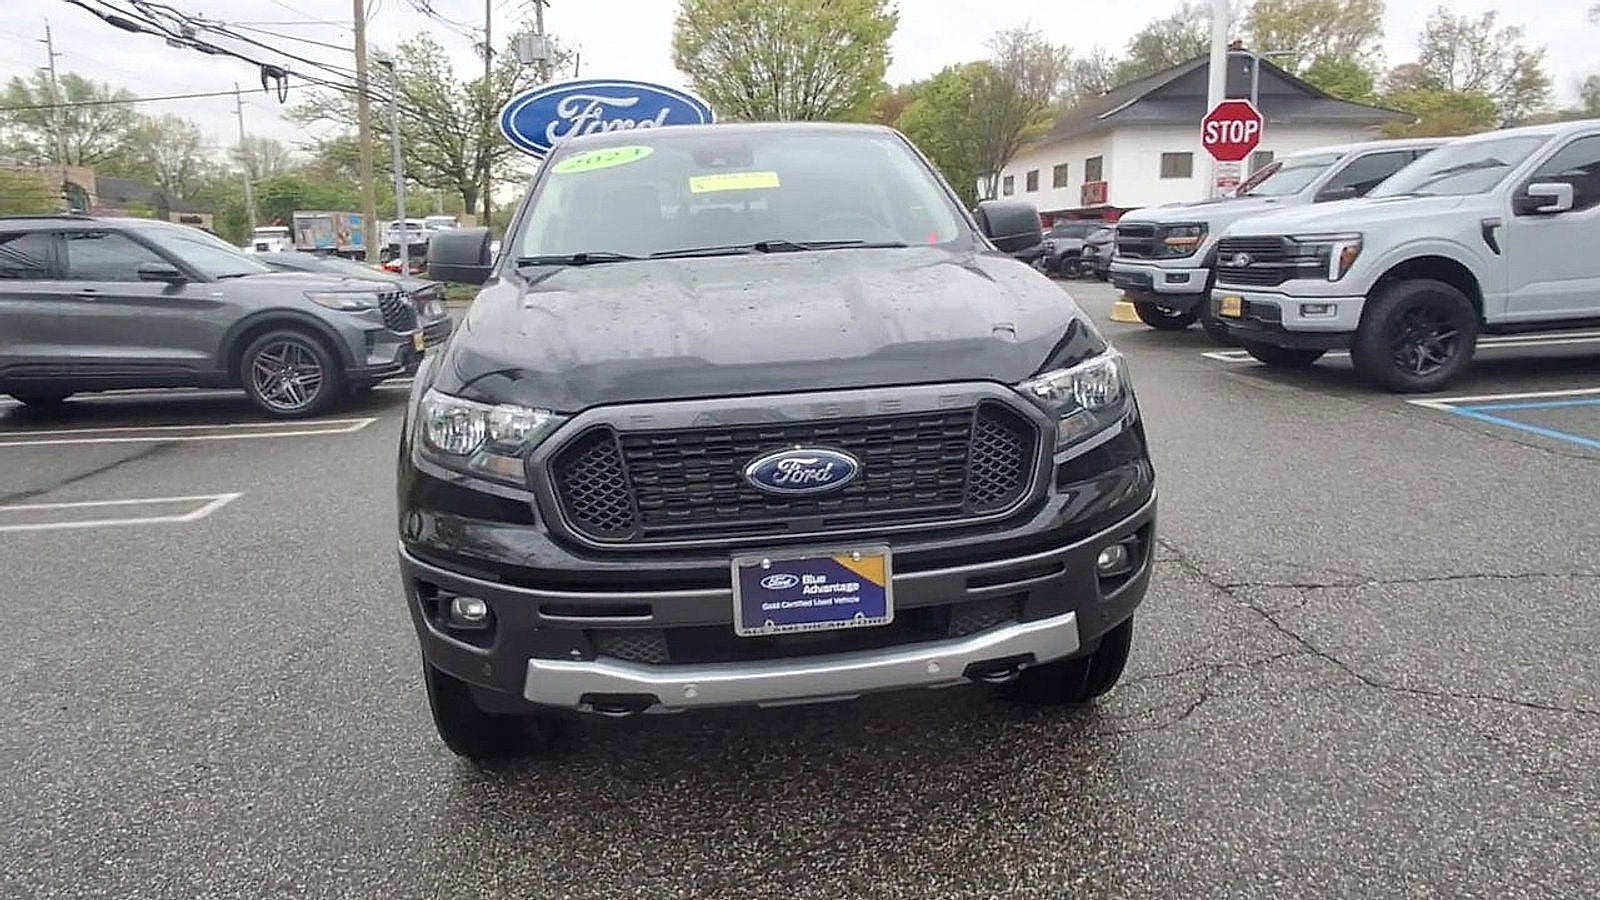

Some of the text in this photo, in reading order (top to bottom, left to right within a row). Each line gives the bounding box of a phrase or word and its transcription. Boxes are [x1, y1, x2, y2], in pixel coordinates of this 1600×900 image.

[546, 94, 671, 145] Ford
[1204, 119, 1258, 144] STOP
[772, 457, 833, 483] Ford
[802, 574, 826, 585] Blue
[802, 582, 860, 595] Advantage
